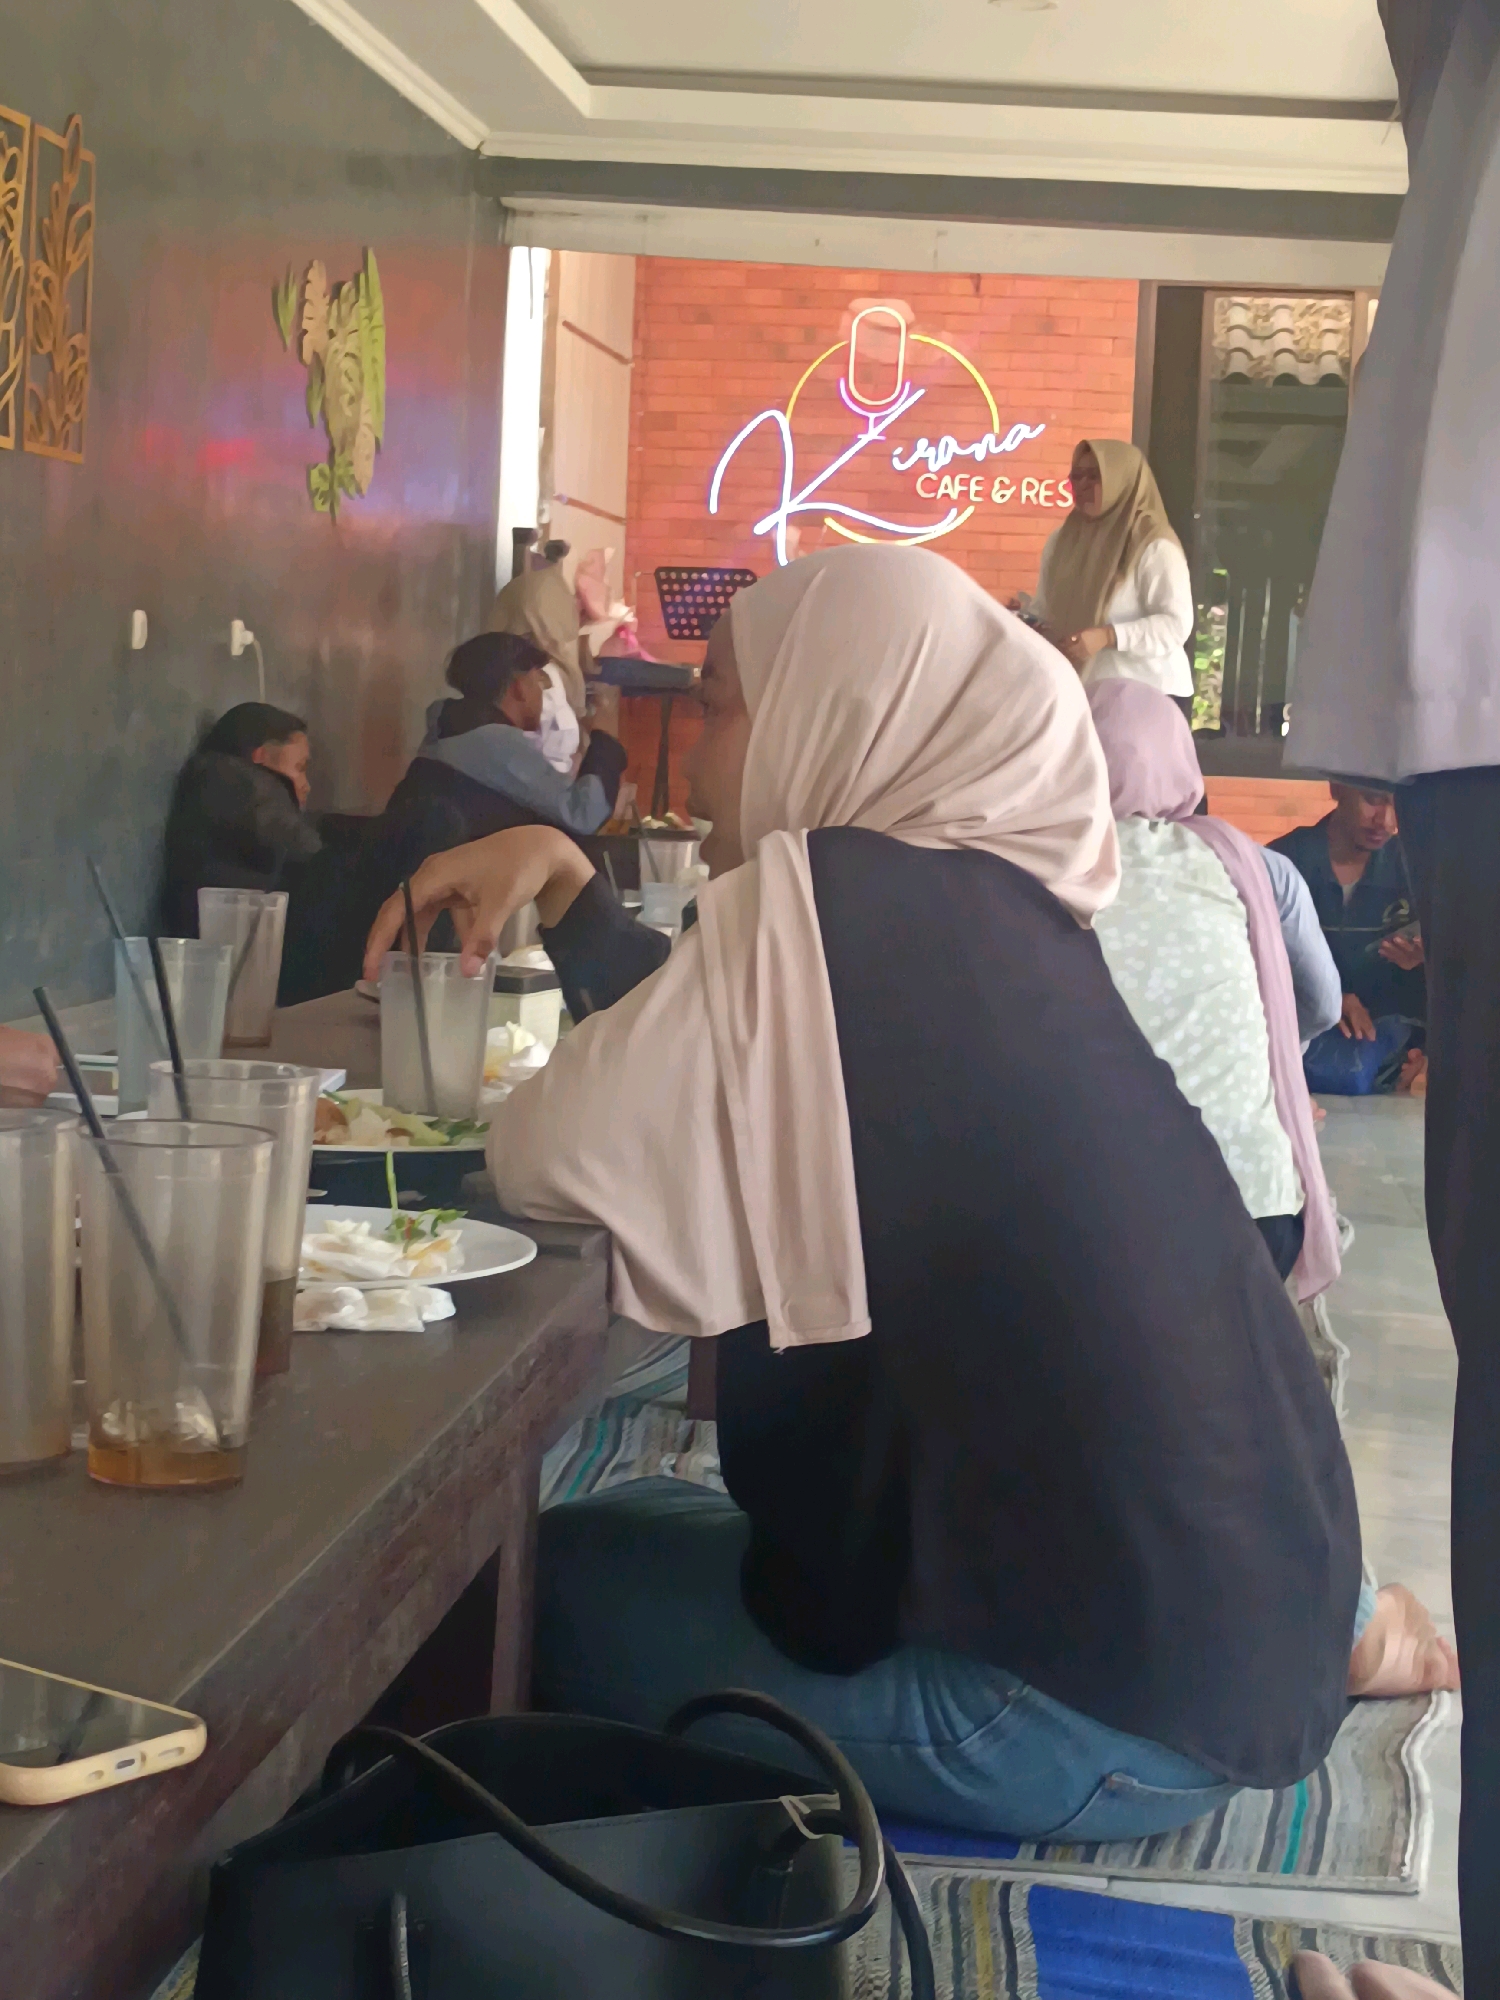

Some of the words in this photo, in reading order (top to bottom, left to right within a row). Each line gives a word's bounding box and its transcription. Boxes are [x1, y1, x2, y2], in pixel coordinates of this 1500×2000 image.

[708, 388, 1046, 566] Kirana
[915, 473, 985, 502] CAFE
[991, 476, 1017, 504] &
